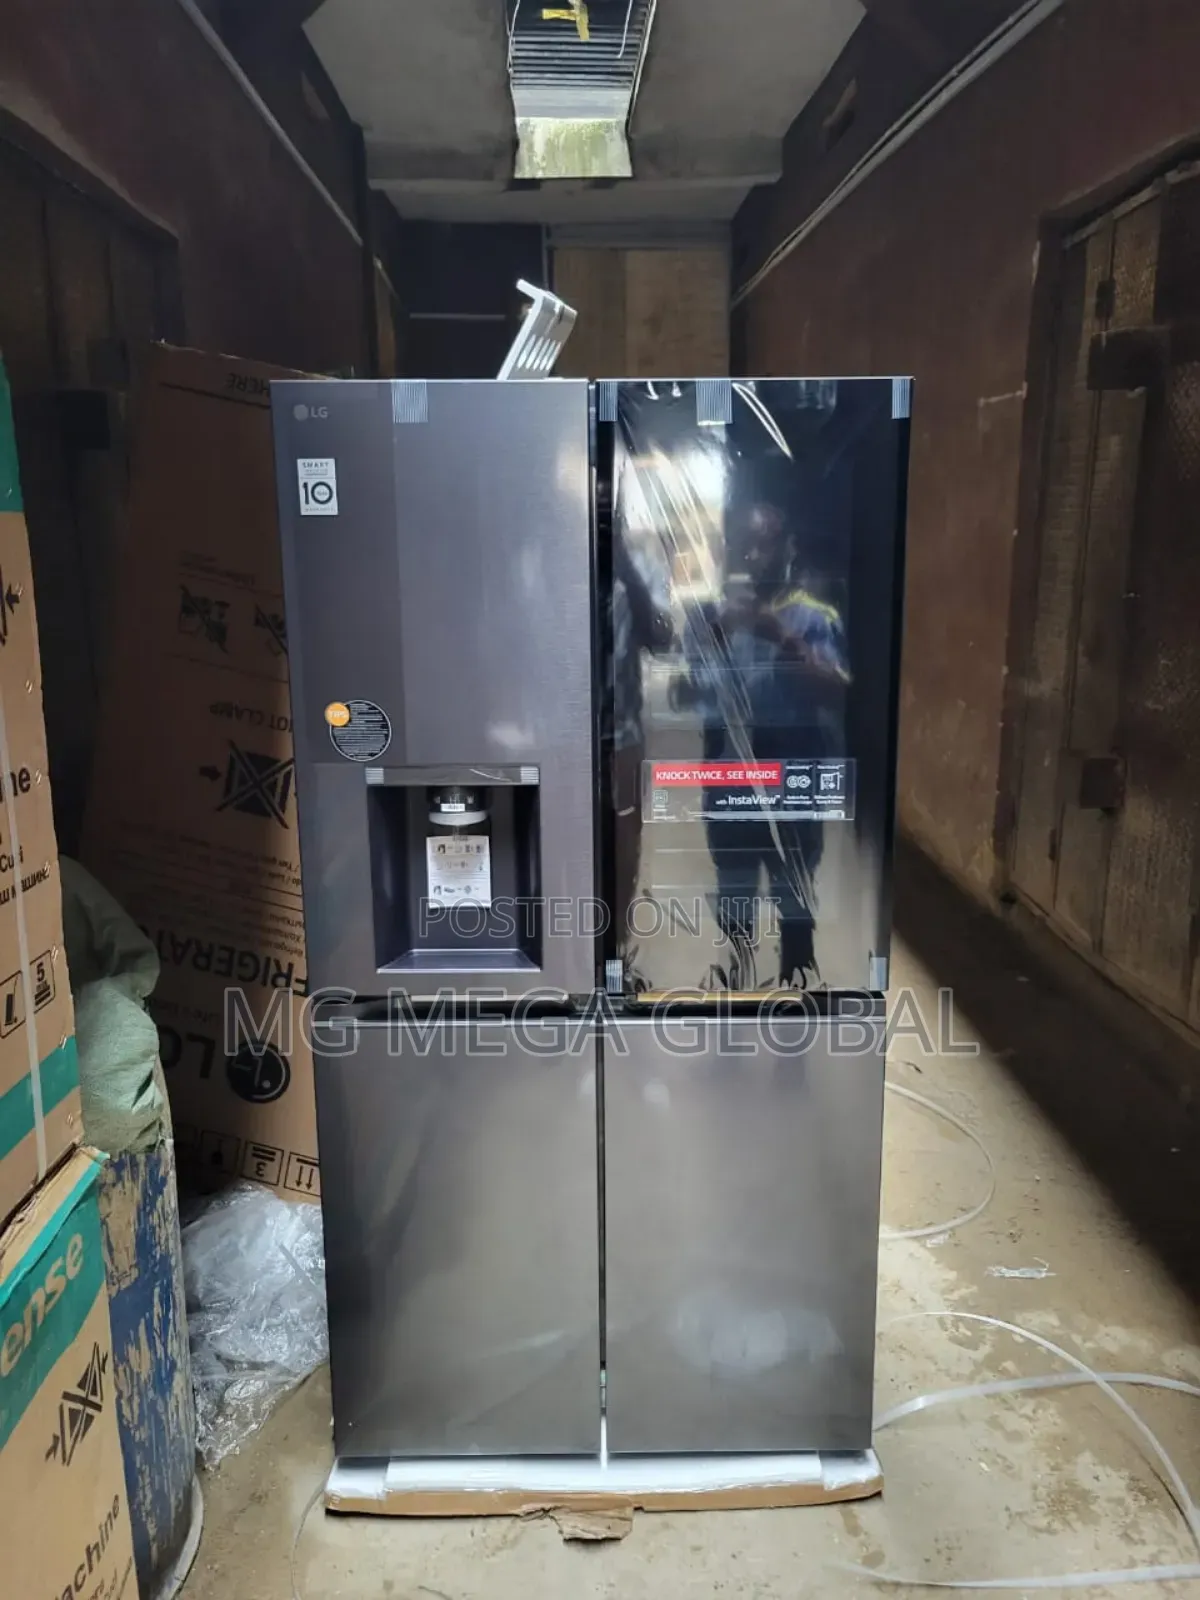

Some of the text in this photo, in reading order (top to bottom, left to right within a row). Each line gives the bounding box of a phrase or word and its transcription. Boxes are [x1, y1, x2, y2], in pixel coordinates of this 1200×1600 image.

[310, 406, 329, 419] LG
[302, 481, 334, 505] 10
[267, 714, 293, 733] OT
[655, 769, 778, 780] KNOCK TWICE, SEE INSIDE
[0, 846, 24, 873] Cui
[138, 924, 309, 997] FRIGERAT
[36, 961, 45, 982] 5
[255, 1161, 267, 1178] 3
